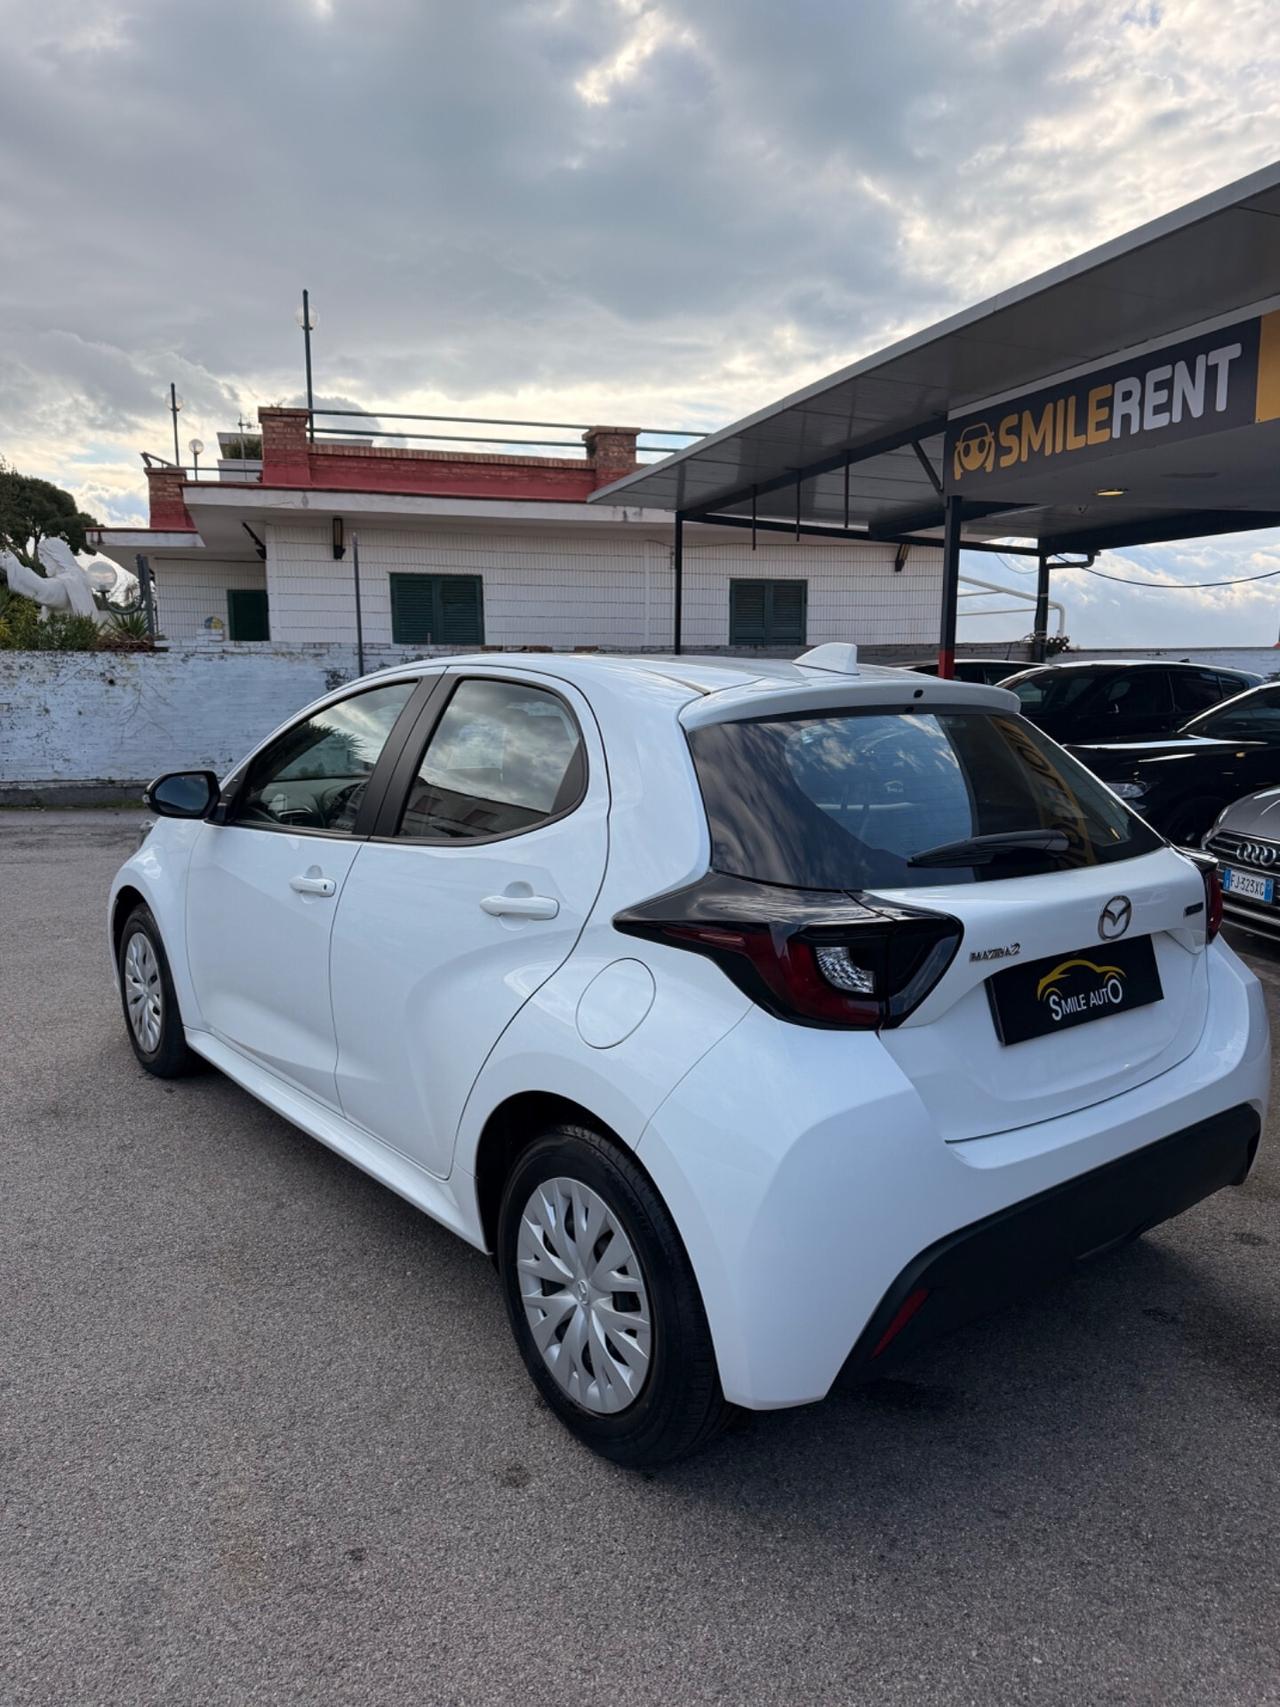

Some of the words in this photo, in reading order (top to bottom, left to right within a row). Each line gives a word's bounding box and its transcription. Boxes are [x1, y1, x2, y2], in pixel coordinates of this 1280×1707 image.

[998, 342, 1242, 469] SMILERENT
[1049, 993, 1087, 1022] SMILE
[1089, 978, 1124, 1010] AUTO
